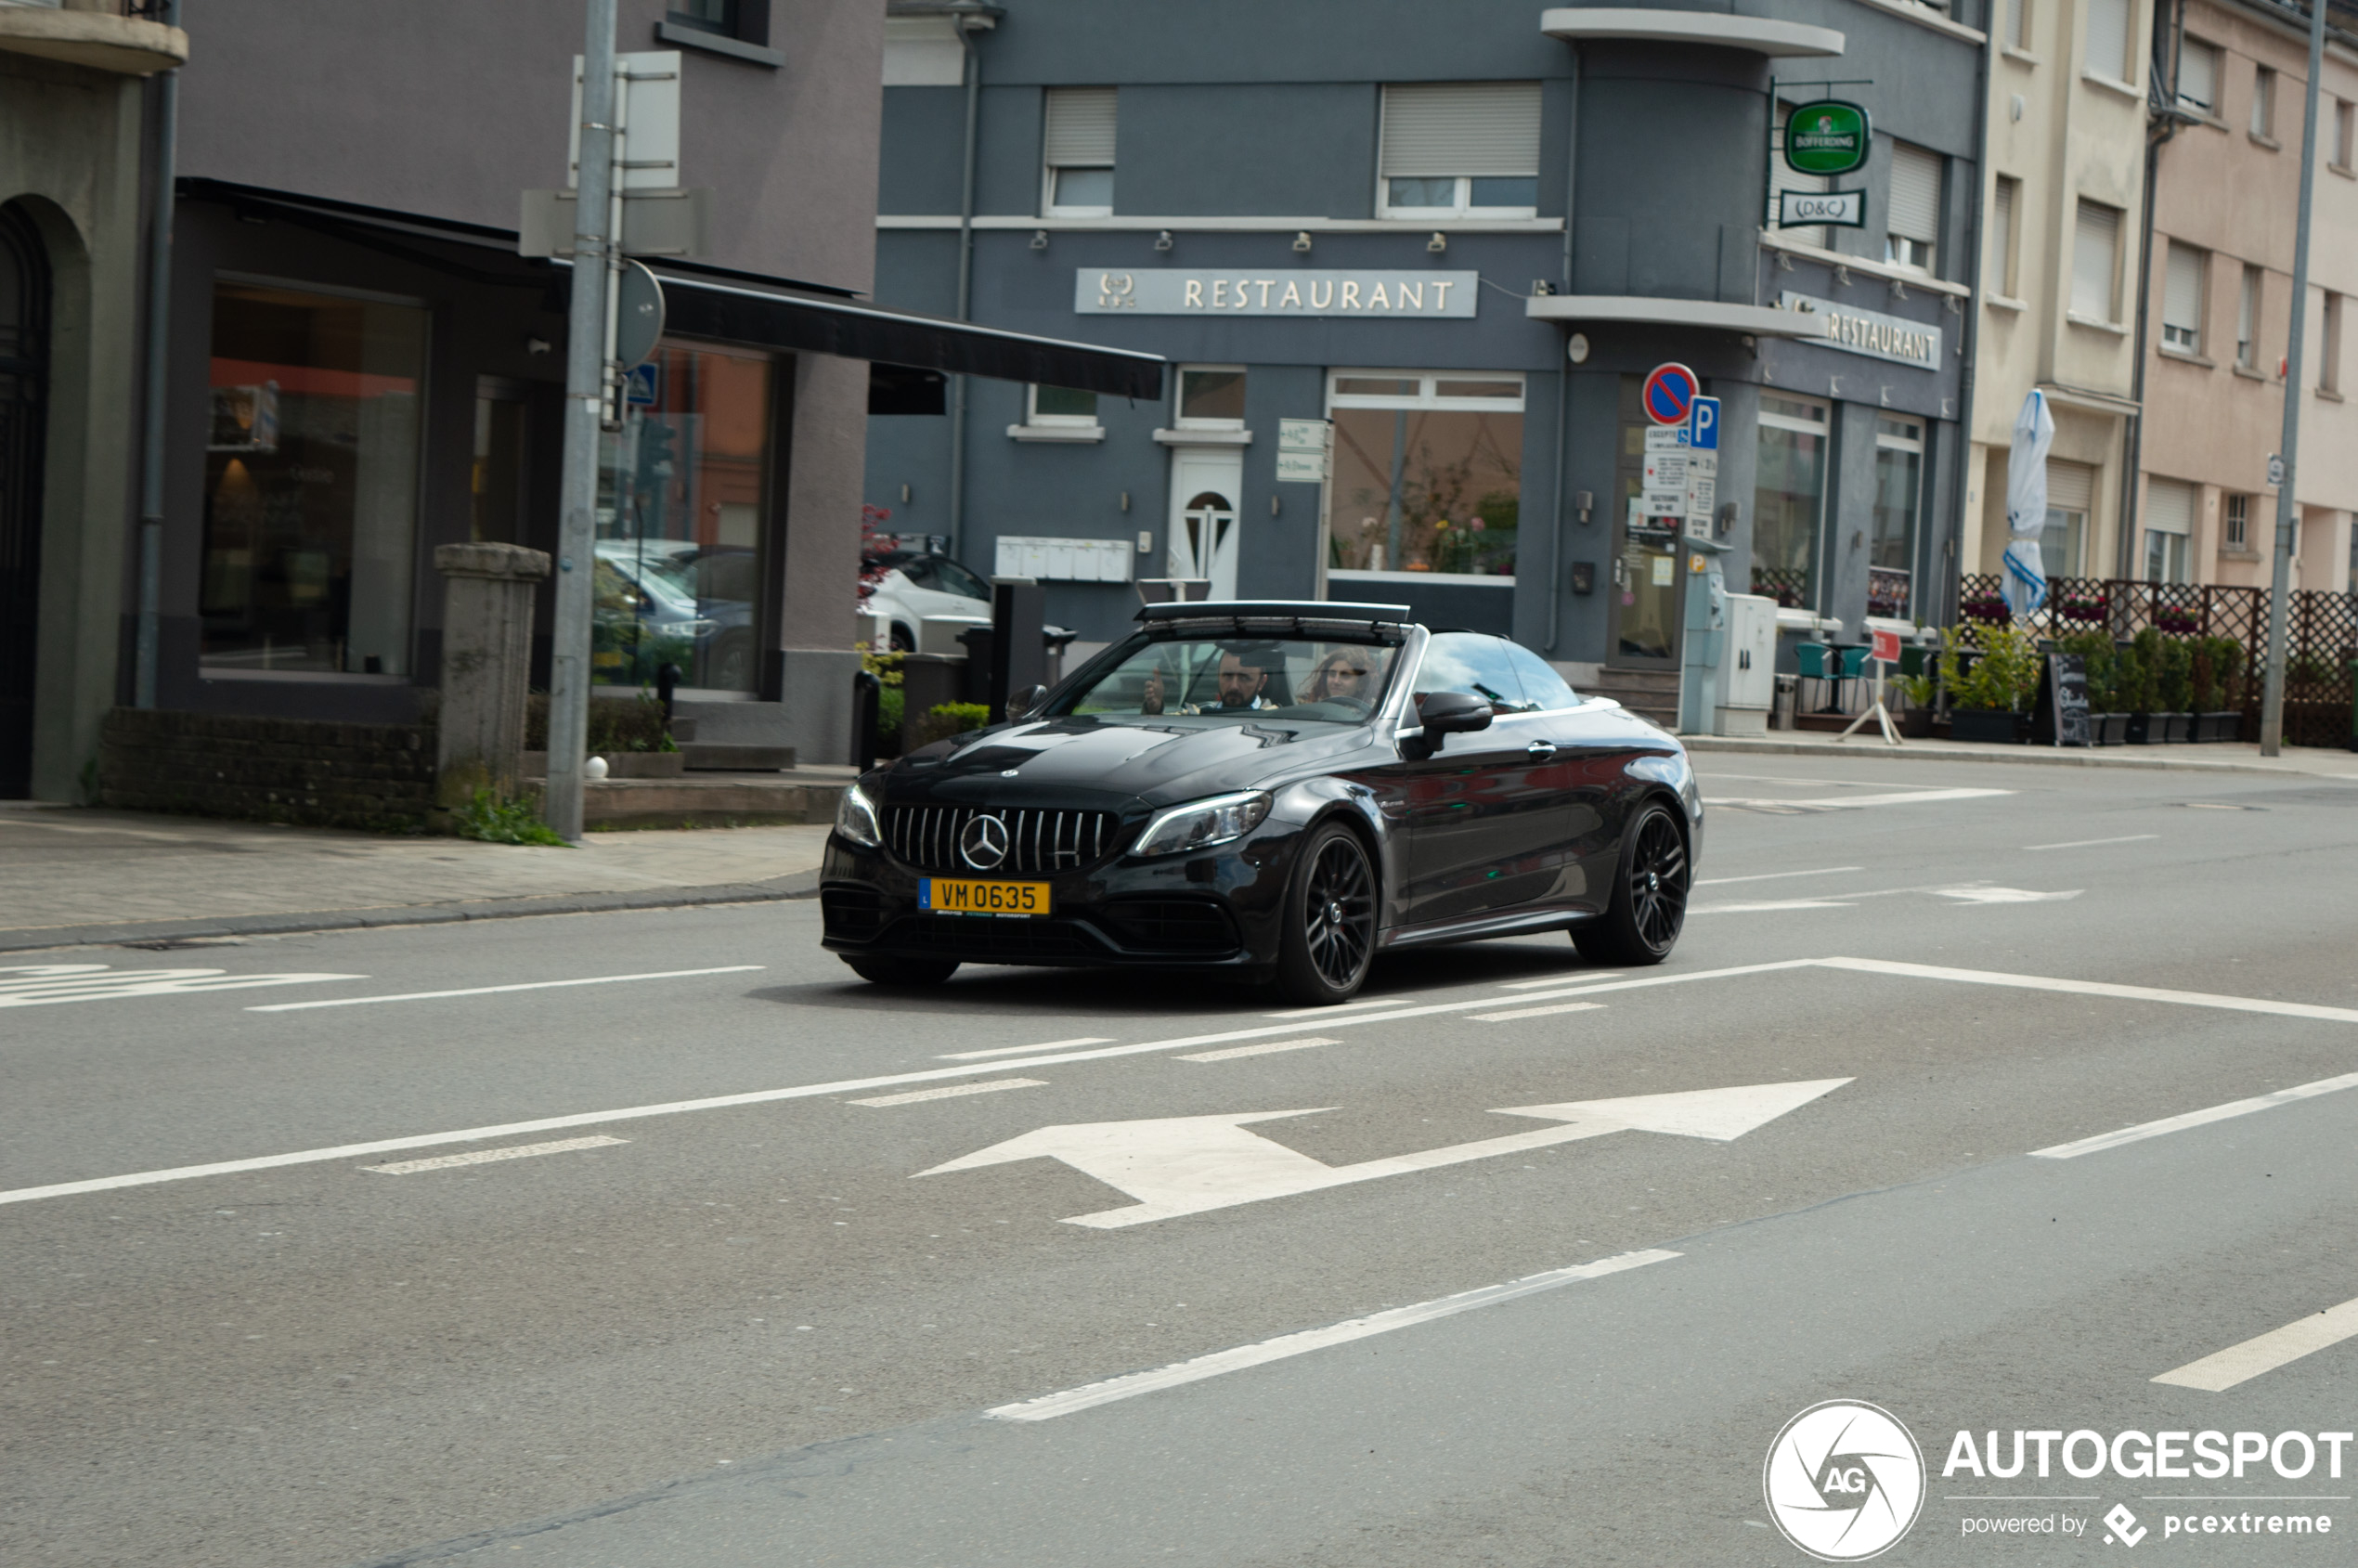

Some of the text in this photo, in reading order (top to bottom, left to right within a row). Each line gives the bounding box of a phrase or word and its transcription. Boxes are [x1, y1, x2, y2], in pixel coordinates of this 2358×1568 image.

[1796, 136, 1853, 149] BOFFERDING
[1185, 279, 1454, 310] RESTAURANT
[1830, 312, 1936, 362] RESTAURANT
[1695, 405, 1714, 442] P
[923, 896, 927, 904] L
[942, 883, 1035, 910] VM 0635
